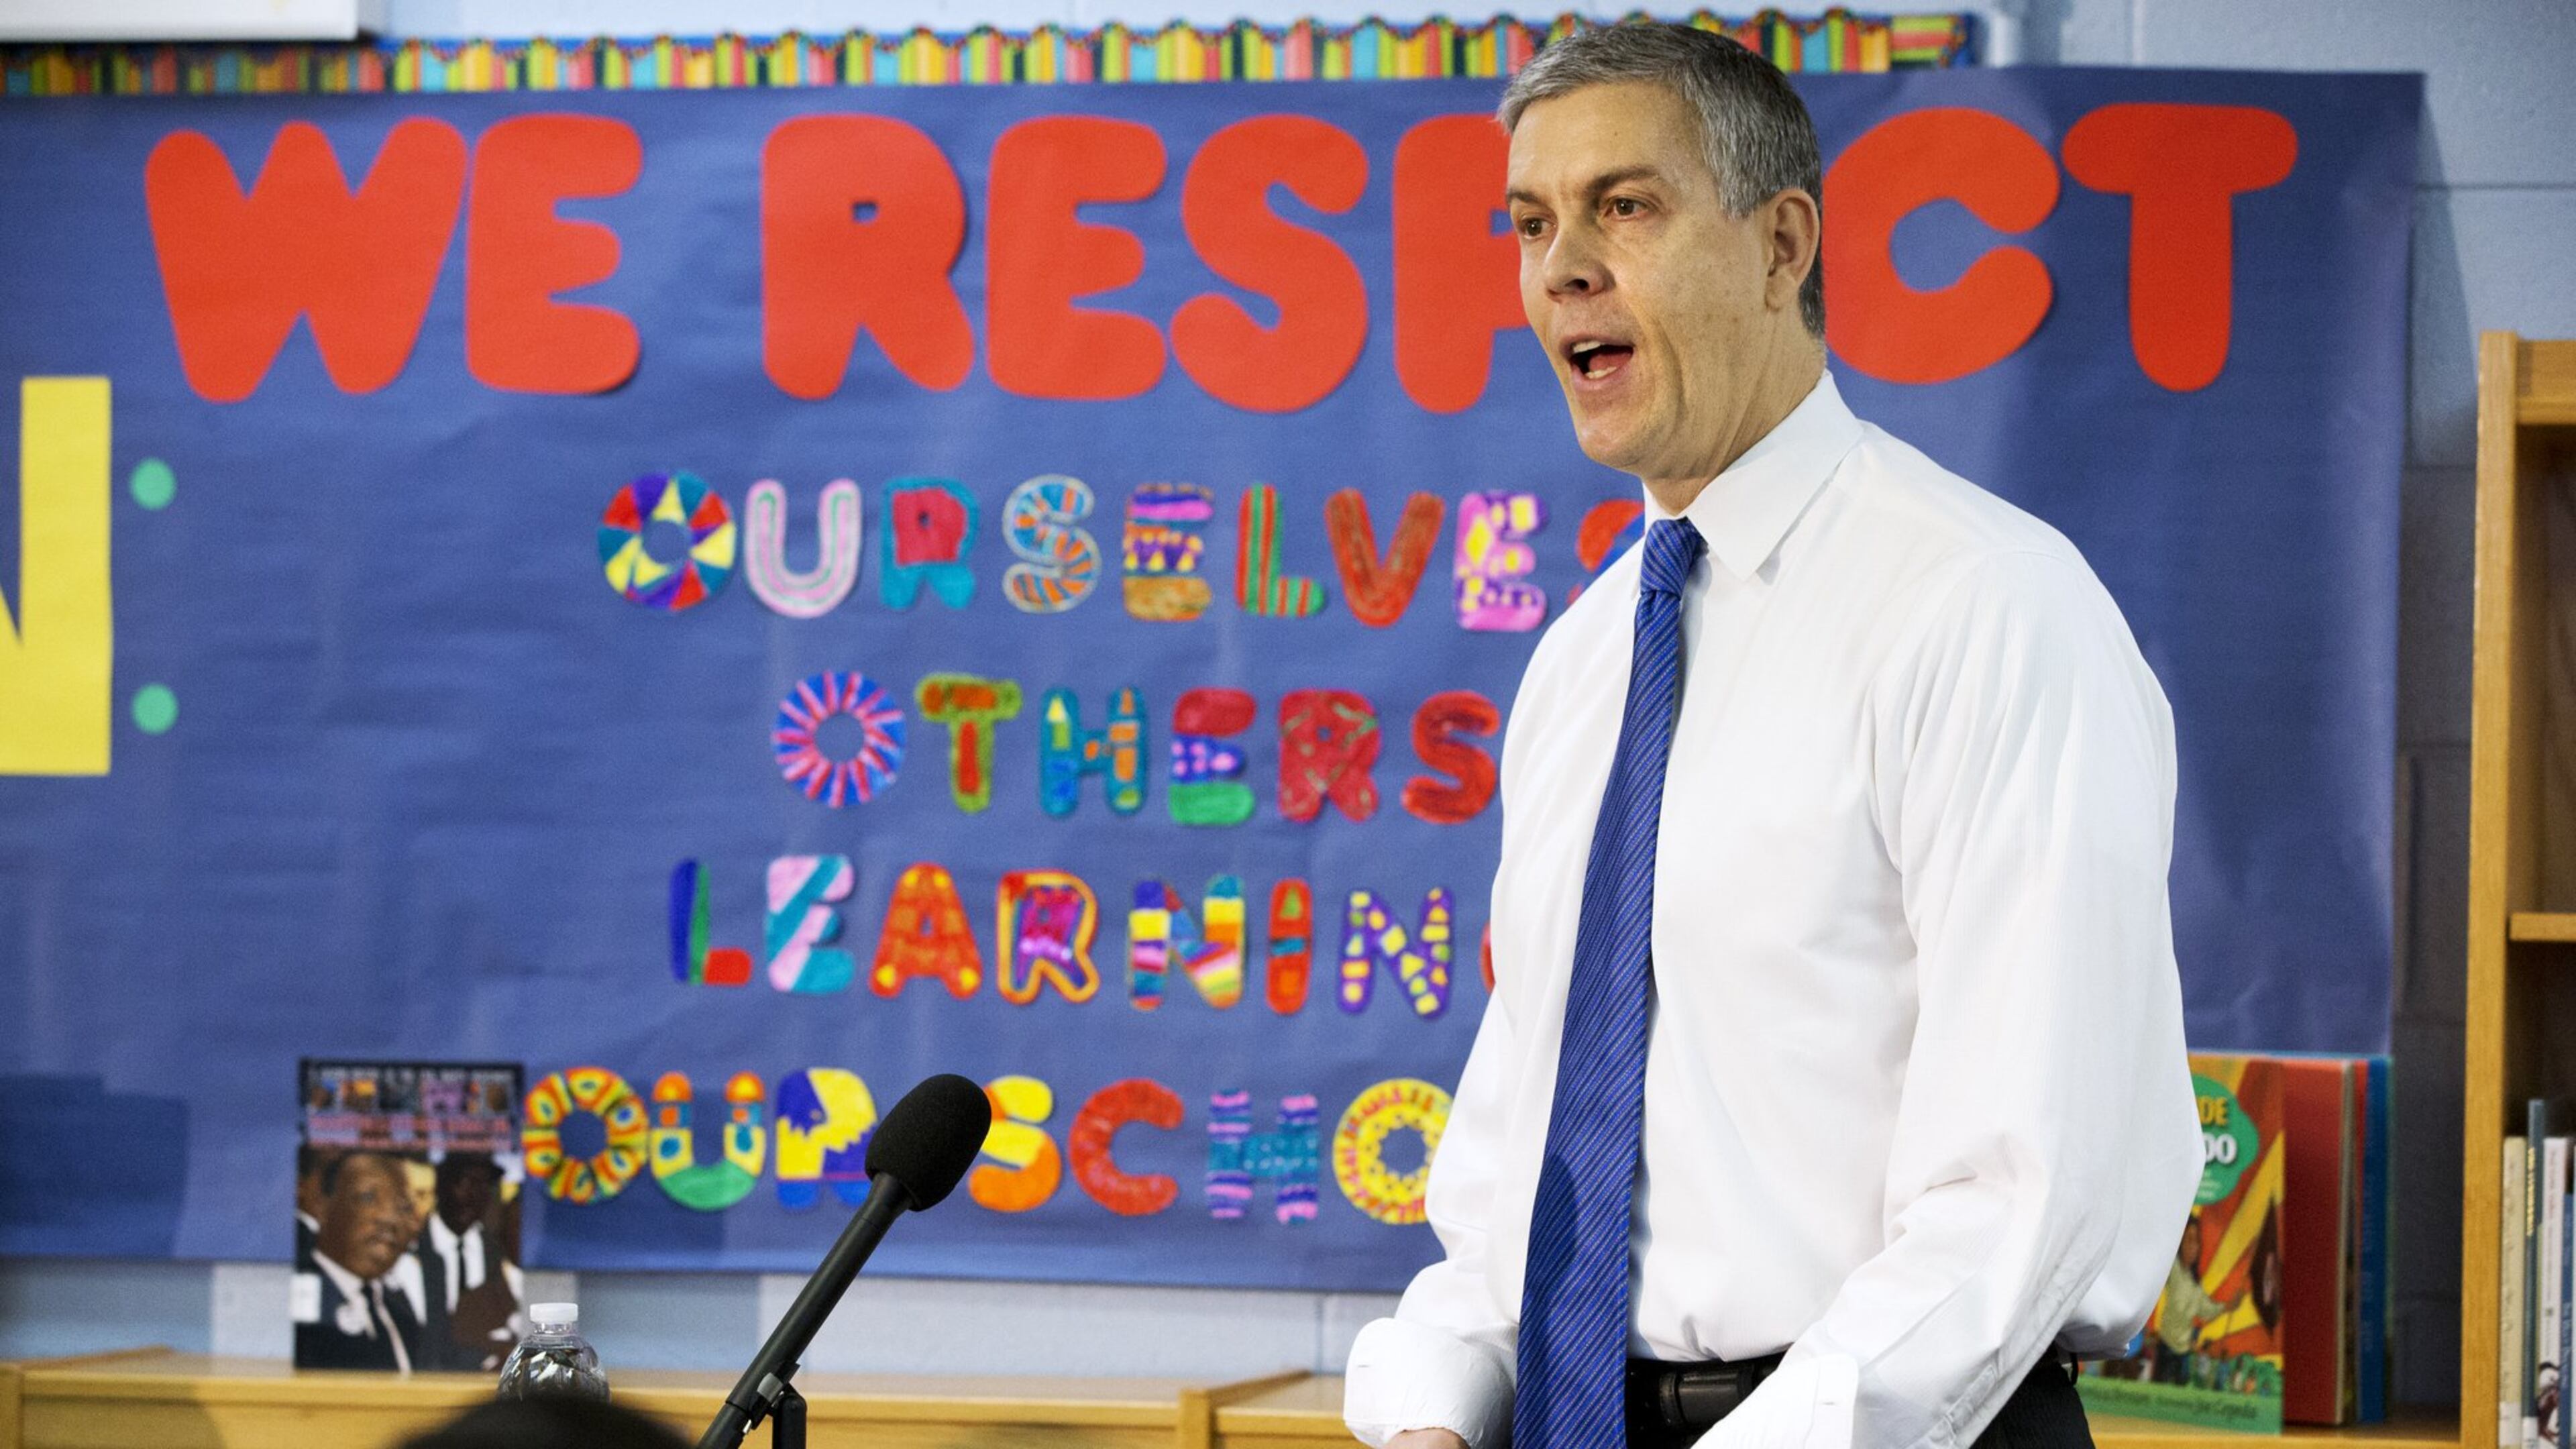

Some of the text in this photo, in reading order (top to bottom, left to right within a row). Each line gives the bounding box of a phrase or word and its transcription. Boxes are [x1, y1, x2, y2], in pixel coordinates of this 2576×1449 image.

[143, 102, 2298, 414] WE RESPCT
[771, 672, 1501, 825] OTHERS
[669, 855, 1495, 1019] LEARNIN
